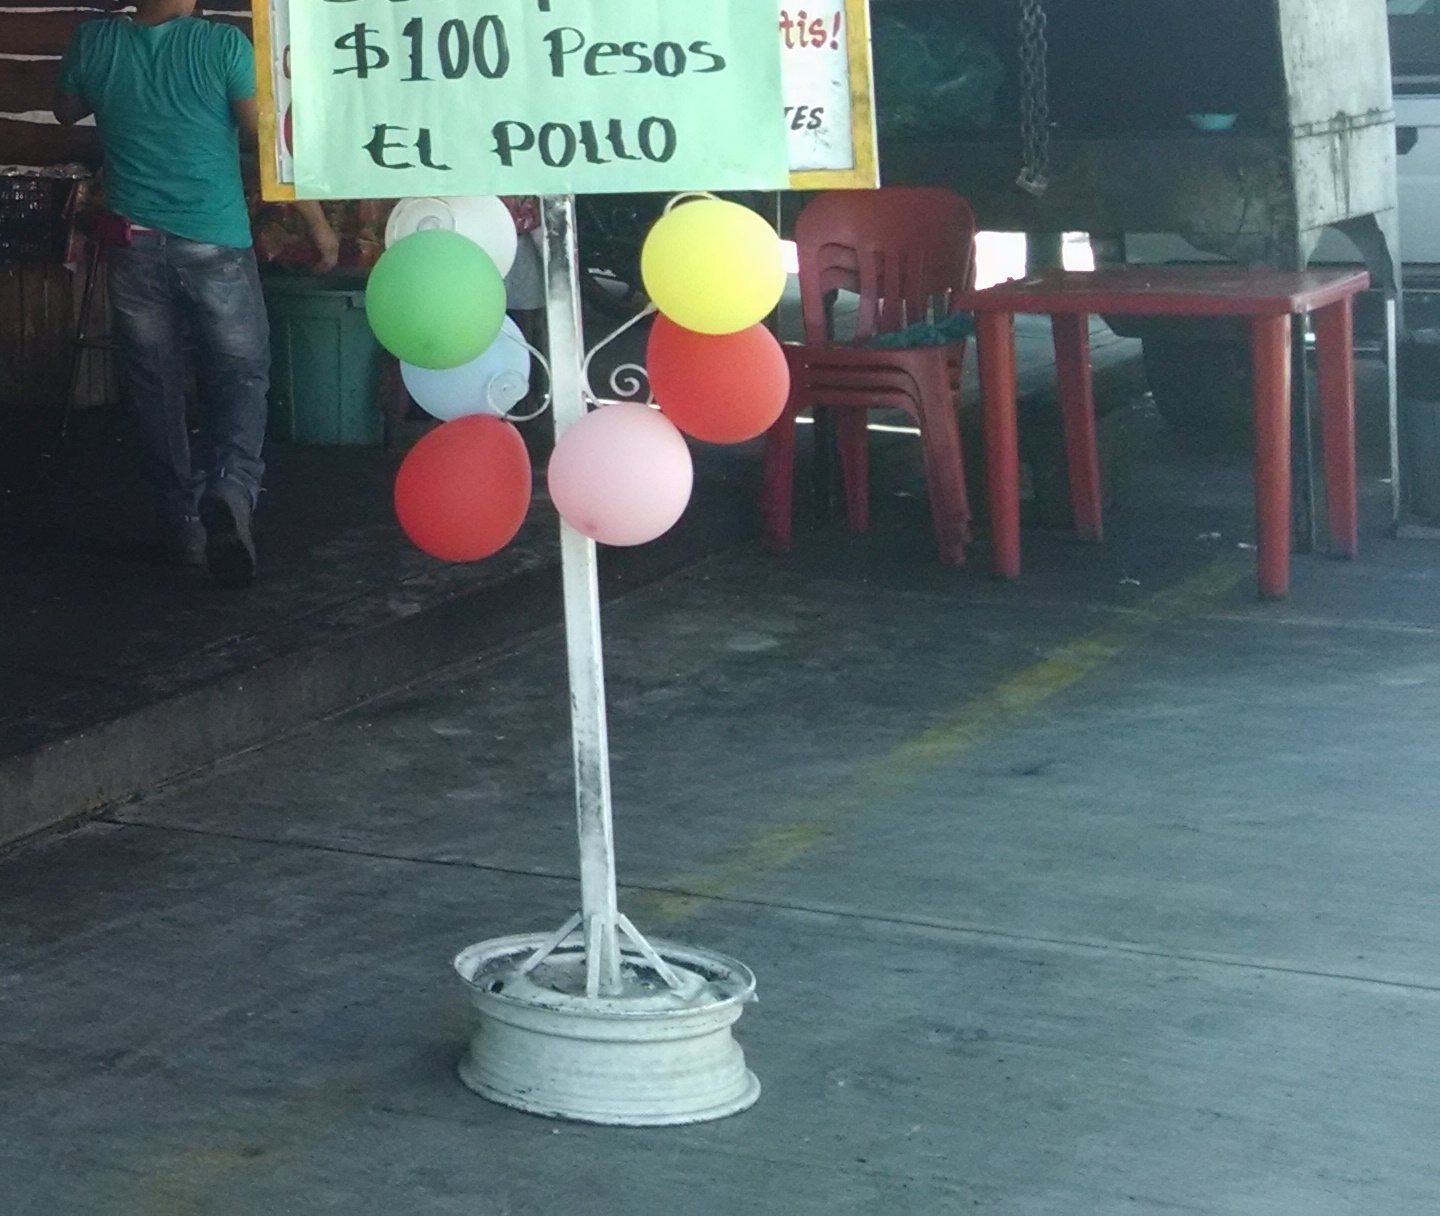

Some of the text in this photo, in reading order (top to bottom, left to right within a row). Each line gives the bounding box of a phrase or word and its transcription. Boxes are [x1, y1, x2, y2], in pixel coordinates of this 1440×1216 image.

[332, 14, 511, 82] $100
[543, 26, 727, 78] Pesos
[362, 116, 678, 171] EL POLLO
